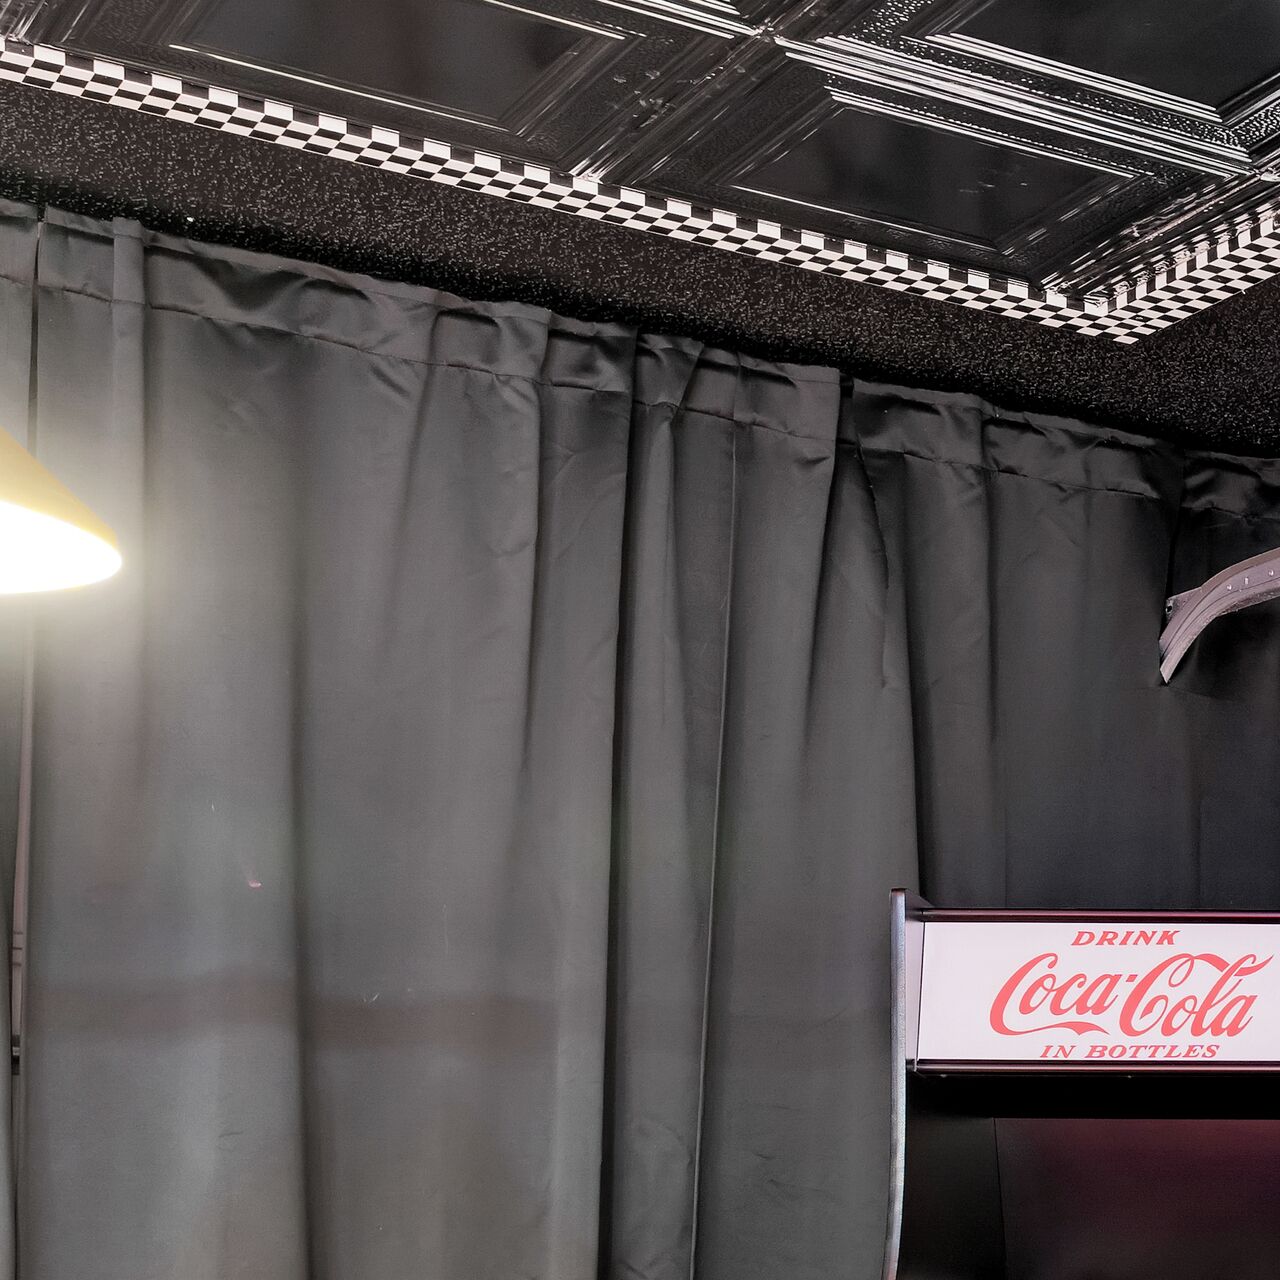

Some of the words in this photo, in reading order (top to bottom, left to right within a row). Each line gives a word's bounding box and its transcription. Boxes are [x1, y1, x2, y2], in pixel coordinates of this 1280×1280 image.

[1071, 930, 1180, 946] DRINK
[1040, 1045, 1076, 1059] IN
[1084, 1045, 1221, 1059] BOTTLES
